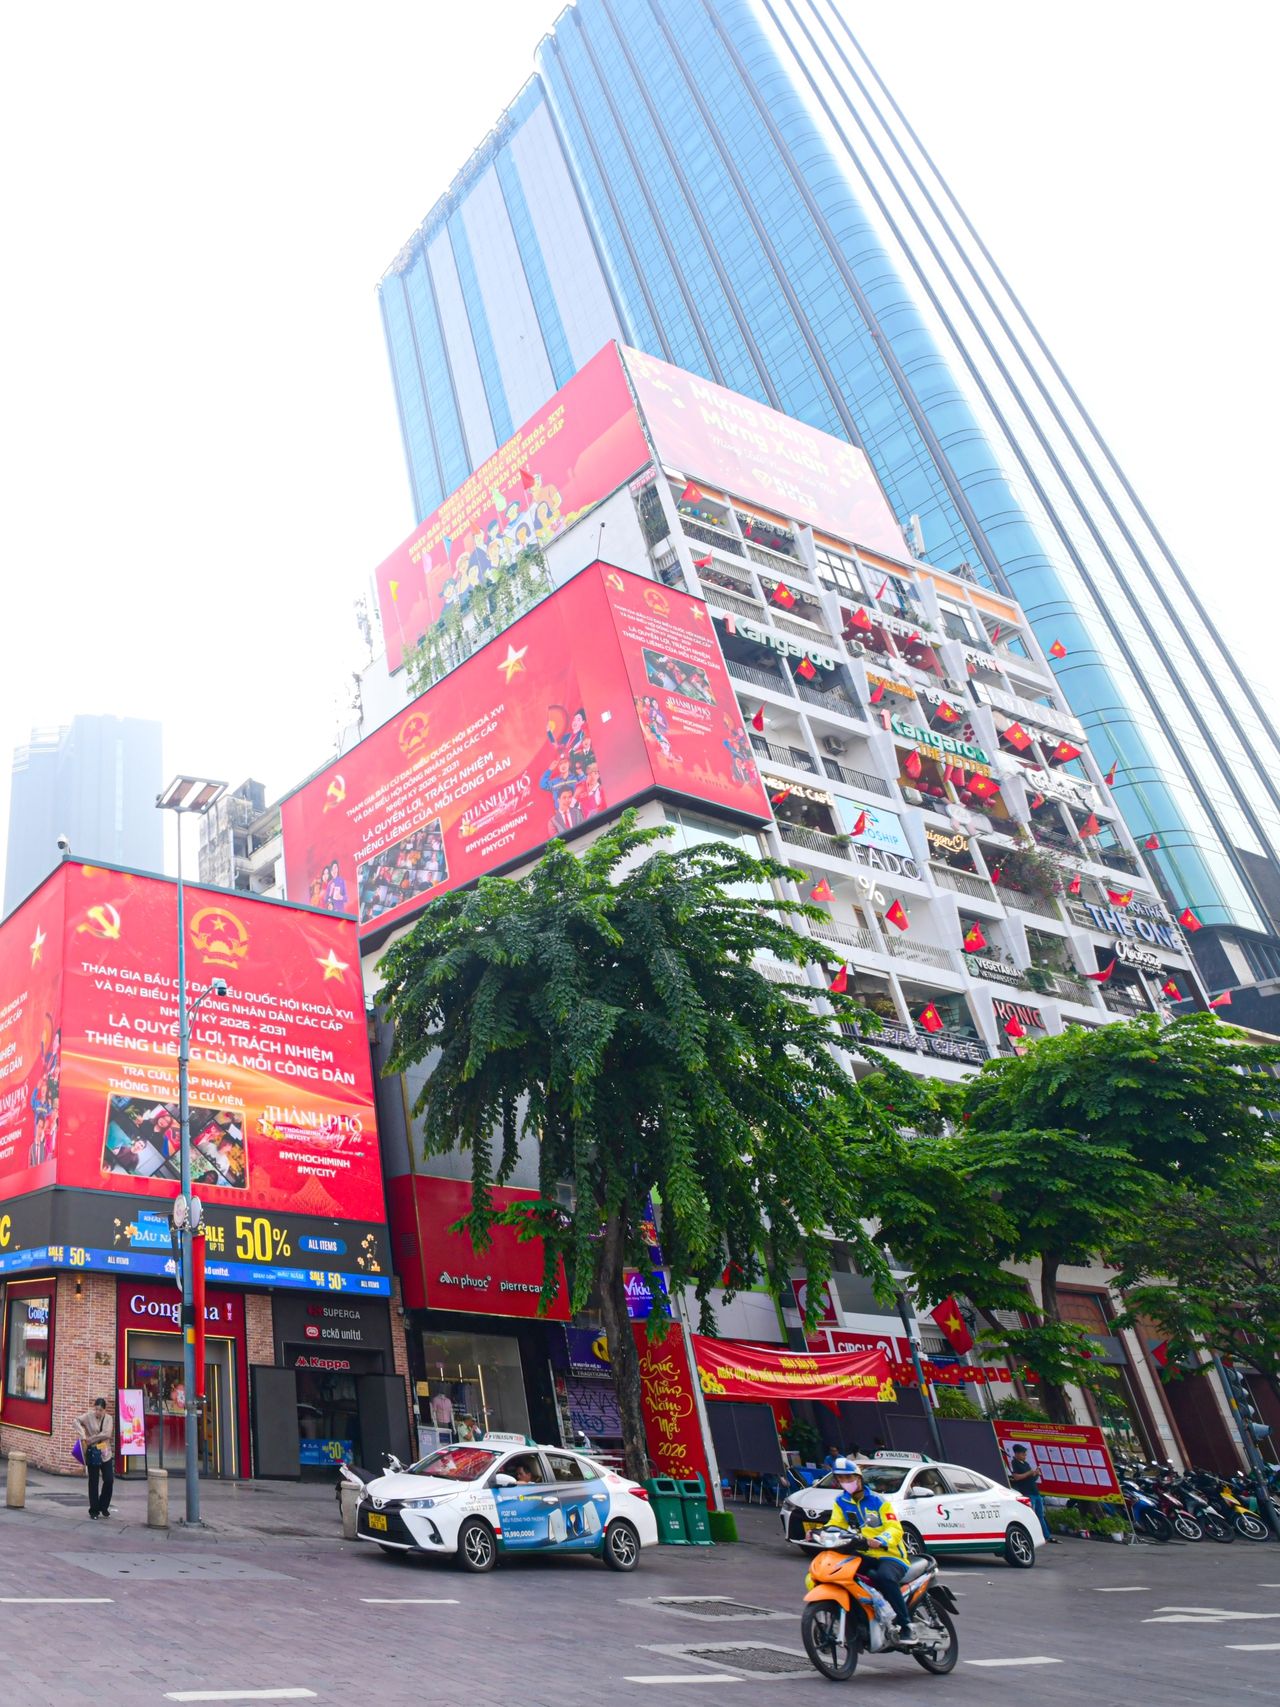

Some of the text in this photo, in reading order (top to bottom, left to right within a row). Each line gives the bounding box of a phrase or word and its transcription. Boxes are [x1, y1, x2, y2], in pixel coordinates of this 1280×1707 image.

[490, 704, 505, 718] XVI
[418, 775, 438, 793] 2026
[441, 760, 460, 777] 2031
[353, 836, 385, 862] THIÊNG
[385, 820, 412, 843] LIÊNG
[454, 774, 485, 799] CÔNG
[486, 756, 512, 779] DÂN
[362, 828, 374, 843] LÀ
[424, 775, 459, 802] TRÁCH
[853, 843, 922, 881] FADO
[1084, 902, 1183, 951] THE ONE
[81, 962, 118, 978] THAM
[120, 968, 142, 982] GIA
[144, 971, 170, 987] BẦU
[244, 990, 277, 1007] QUỐC
[279, 997, 300, 1011] HỘI
[335, 1009, 354, 1020] XVI
[94, 977, 113, 991] VÀ
[115, 983, 137, 997] ĐẠI
[139, 986, 170, 1001] BIỂU
[232, 1001, 266, 1018] NHÂN
[268, 1007, 294, 1022] DÂN
[295, 1011, 319, 1026] CÁC
[320, 1017, 344, 1032] CẤP
[201, 1011, 287, 1037] KỲ 2026 2031
[108, 1013, 334, 1063] LÀ LỢI, TRÁCH NHIỆM
[85, 1029, 356, 1085] THIÊNG CỦA MỖI CÔNG DÂN
[122, 1065, 145, 1078] TRA
[201, 1077, 232, 1091] NHẬT
[108, 1077, 149, 1093] THÔNG
[151, 1083, 170, 1096] TIN
[217, 1093, 246, 1107] VIÊN.
[266, 1104, 363, 1134] THÀNH PHỐ
[279, 1150, 351, 1169] #MYHOCHIMINH
[297, 1165, 336, 1178] #MYCITY
[48, 1246, 64, 1258] SALE
[235, 1215, 291, 1263] 50%
[308, 1238, 338, 1252] ALL ITEMS
[69, 1247, 91, 1266] 50%
[500, 1281, 528, 1293] pierre
[130, 1295, 182, 1324] Gong
[322, 1308, 361, 1320] SUPERGA
[310, 1356, 350, 1370] Kappa
[658, 1442, 686, 1459] 2026
[885, 1451, 910, 1459] VINASUN
